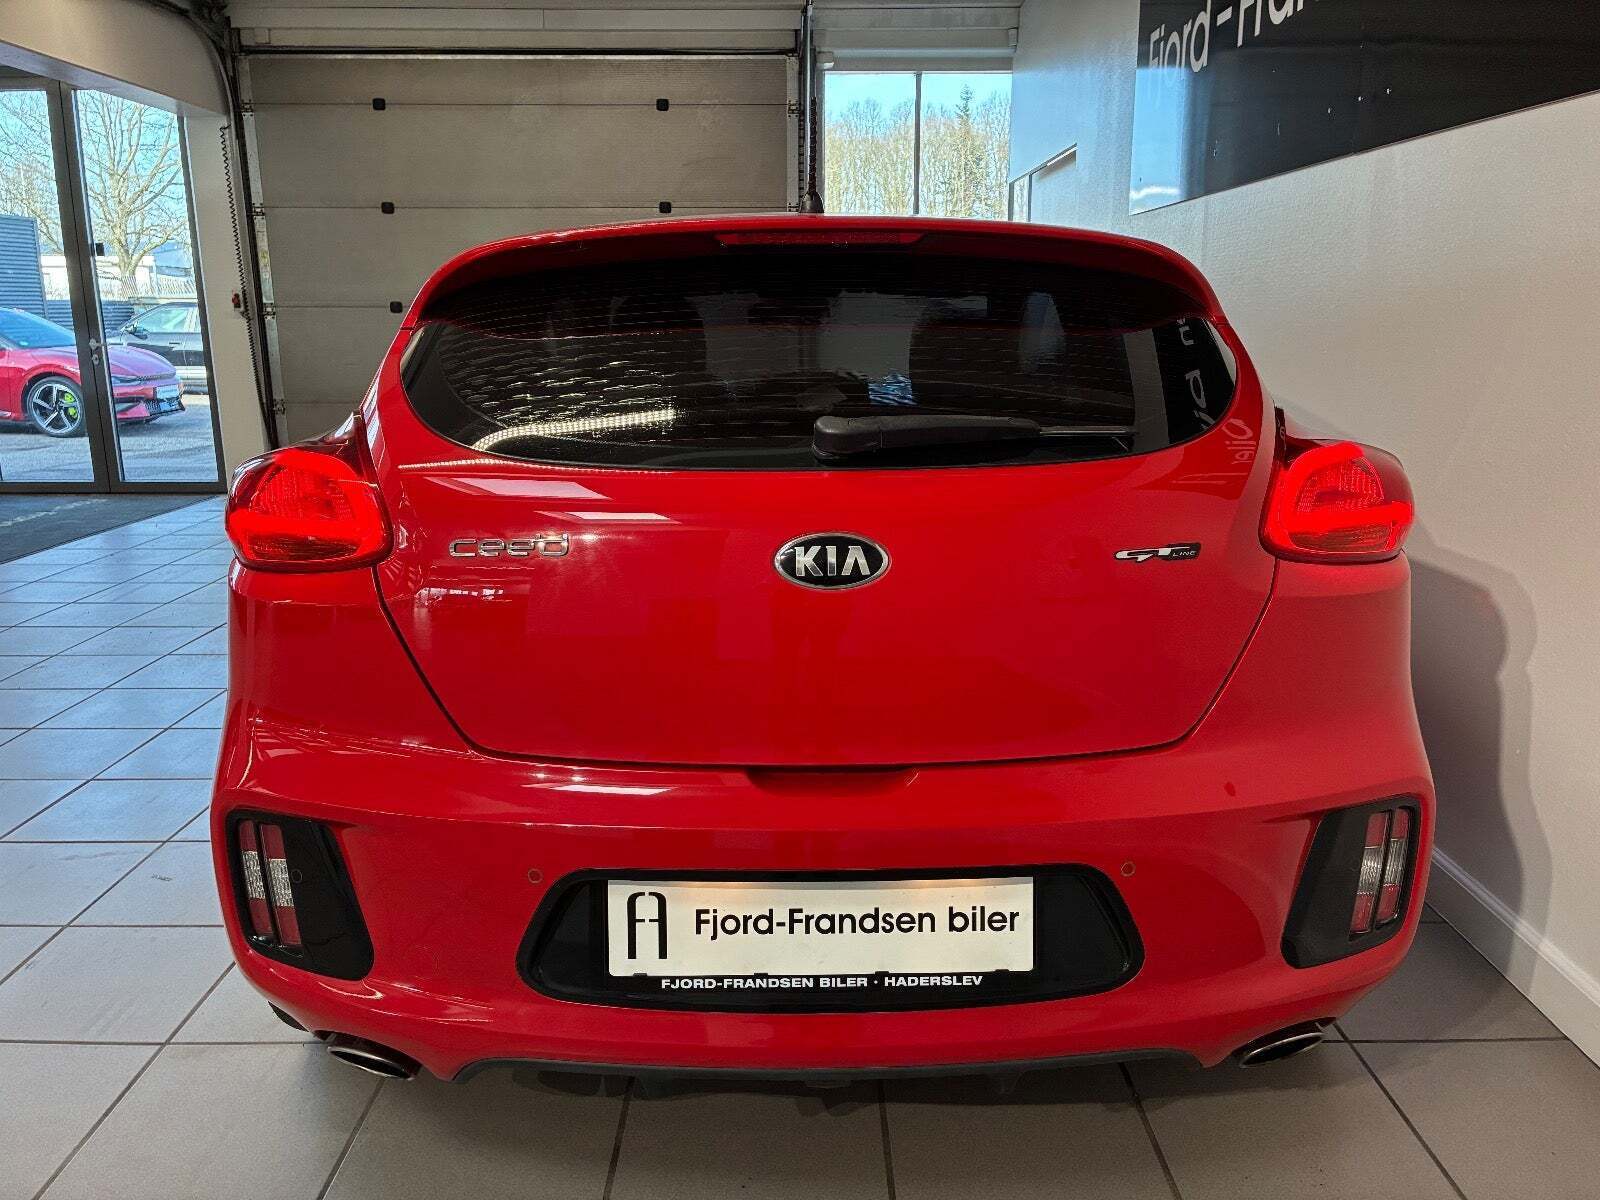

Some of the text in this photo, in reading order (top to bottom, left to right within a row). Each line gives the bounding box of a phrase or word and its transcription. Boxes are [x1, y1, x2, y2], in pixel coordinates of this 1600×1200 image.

[795, 545, 871, 577] KIA
[695, 905, 1020, 941] Fjord-Frandsen biler
[661, 975, 983, 990] FJORD-FRANDSEN BILER HADERSLEV
